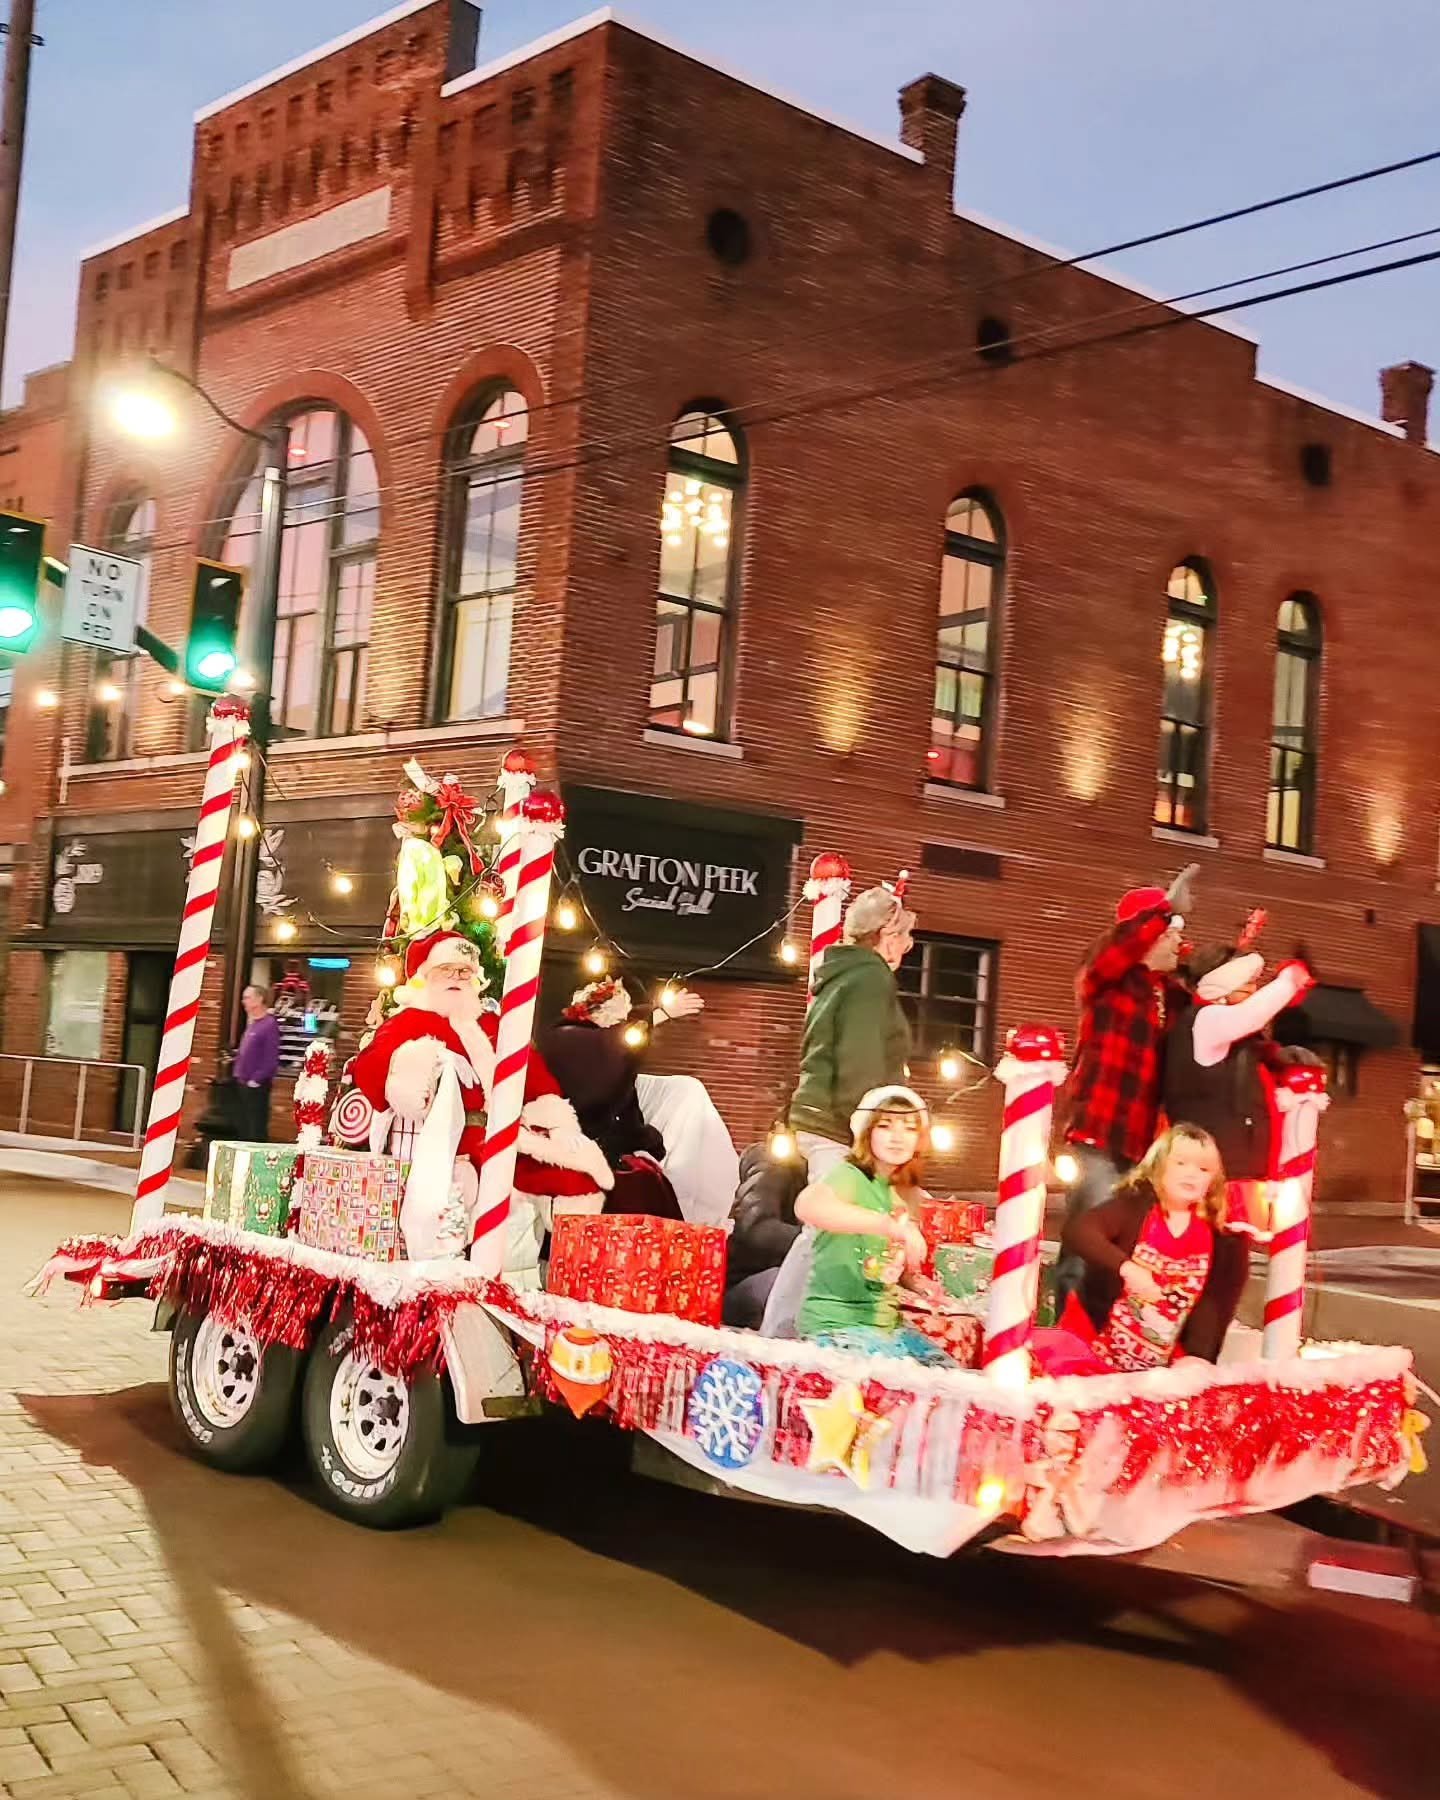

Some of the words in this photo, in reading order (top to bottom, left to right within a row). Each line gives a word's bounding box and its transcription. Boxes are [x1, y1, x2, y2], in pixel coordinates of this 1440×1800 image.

[88, 558, 123, 580] NO
[82, 579, 125, 602] TURN
[88, 603, 112, 620] ON
[82, 622, 112, 640] RED
[577, 847, 701, 888] GRAFTON
[704, 864, 760, 896] PEEK
